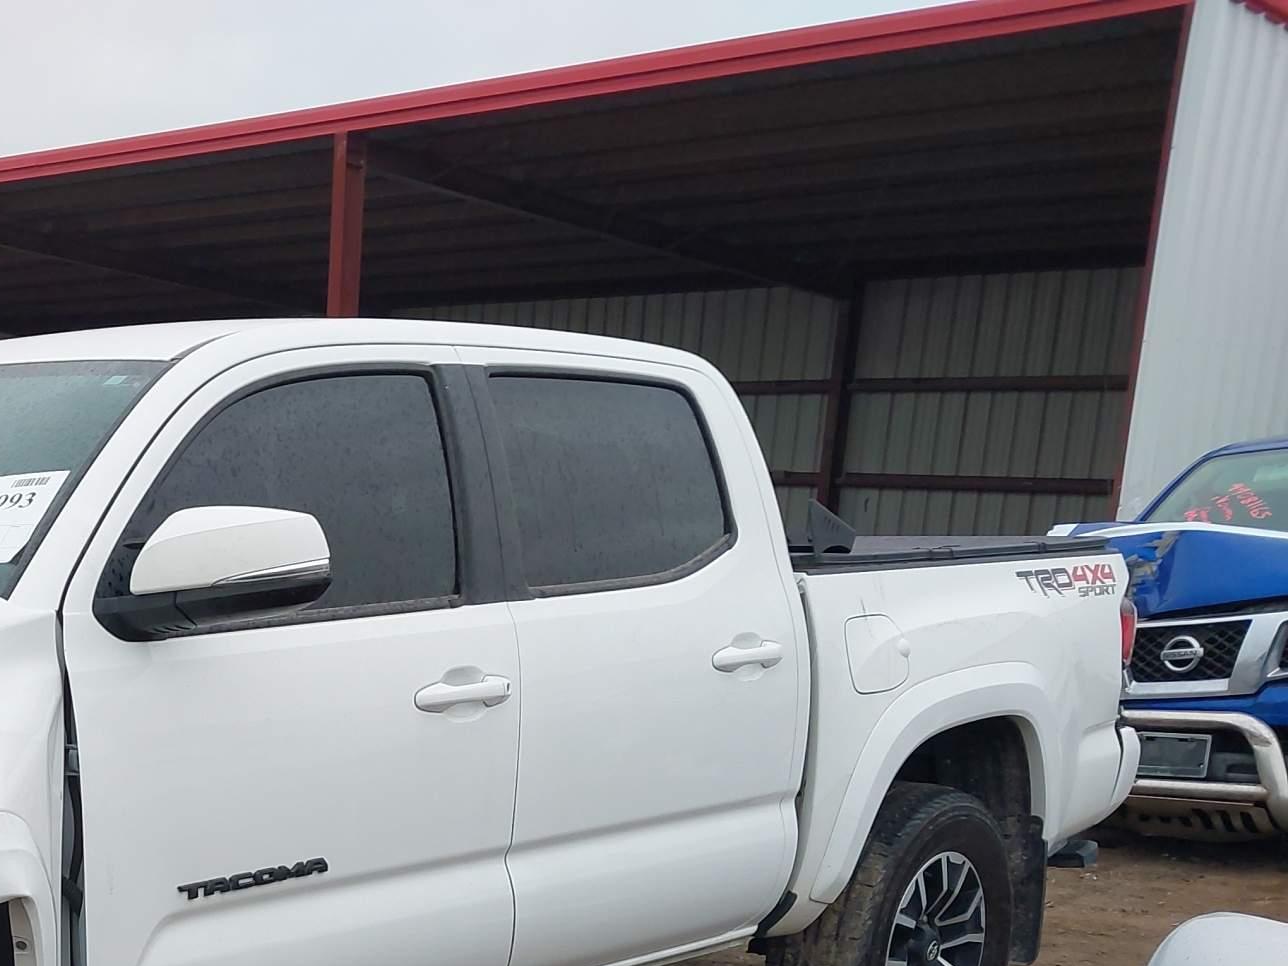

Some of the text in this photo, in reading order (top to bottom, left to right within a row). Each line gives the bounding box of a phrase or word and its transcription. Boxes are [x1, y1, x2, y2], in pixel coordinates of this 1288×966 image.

[1015, 567, 1074, 597] TRD
[1077, 583, 1117, 598] SPORT
[177, 857, 329, 900] TACOMA
